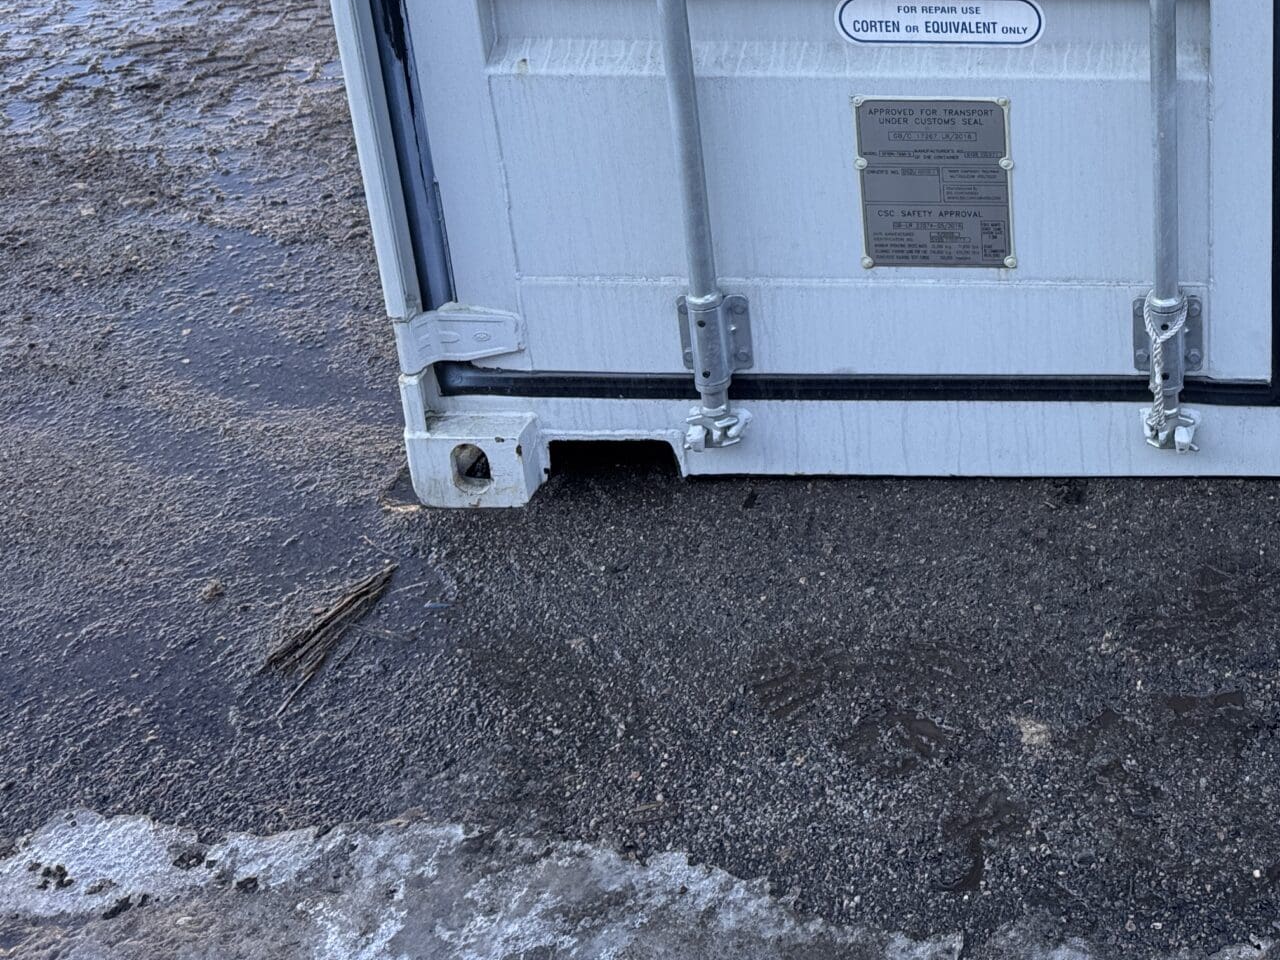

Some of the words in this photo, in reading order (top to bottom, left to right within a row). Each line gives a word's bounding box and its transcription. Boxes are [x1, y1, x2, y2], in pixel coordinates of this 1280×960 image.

[897, 6, 917, 14] FOR
[921, 6, 957, 14] REPAIR
[961, 6, 981, 14] USE
[853, 20, 900, 33] CORTEN
[905, 25, 919, 33] OR
[925, 21, 997, 34] EQUIVALENT
[1002, 26, 1028, 34] ONLY
[868, 108, 914, 116] APPROVED
[943, 109, 994, 117] TRANSPORT
[939, 210, 983, 218] APPROVAL
